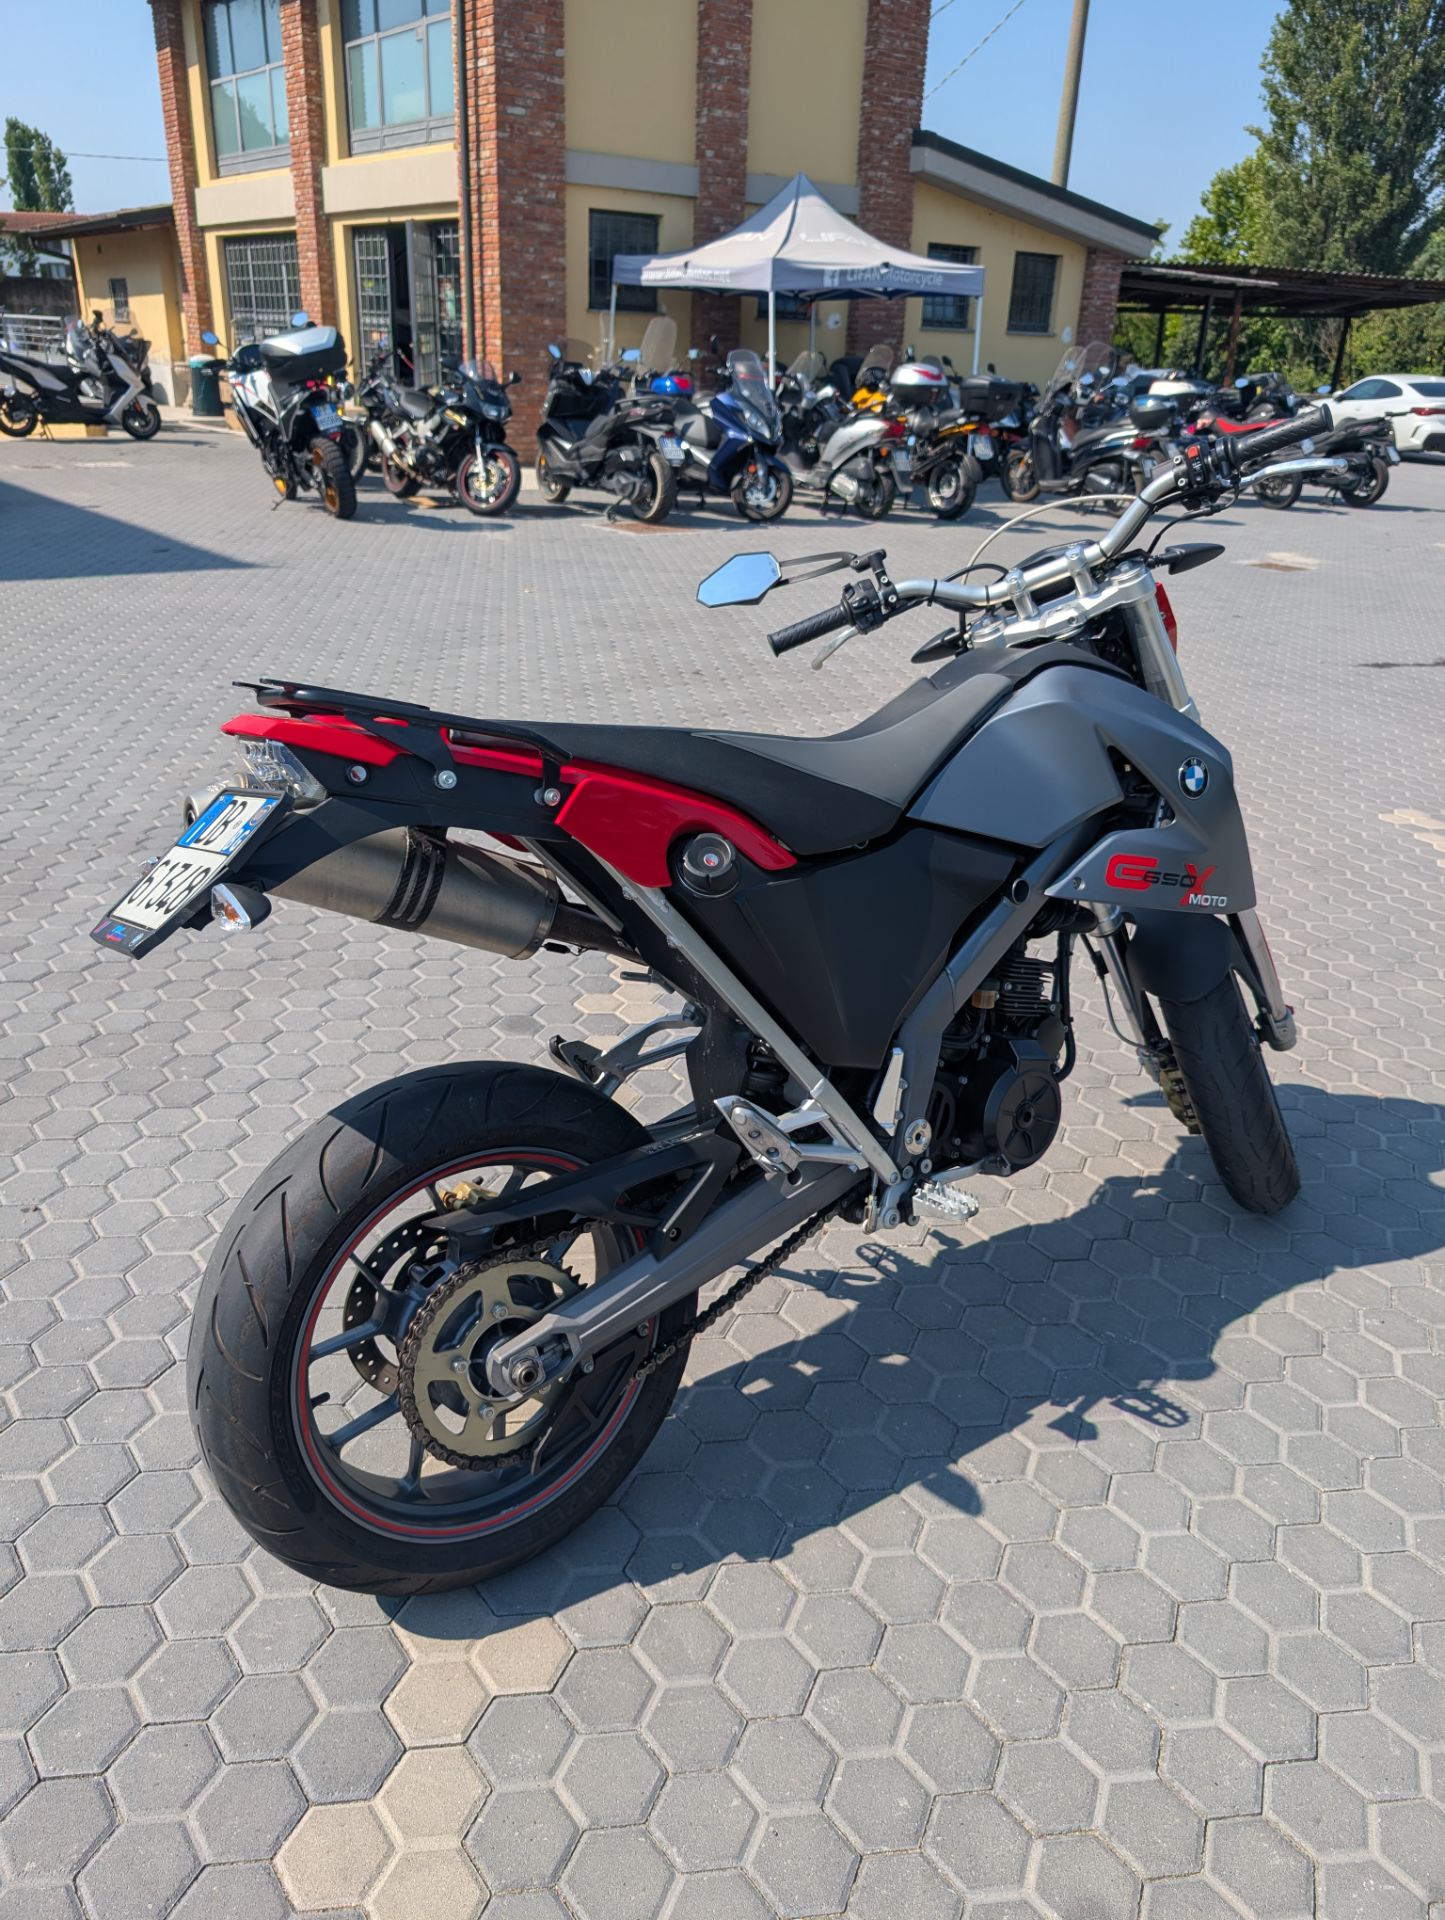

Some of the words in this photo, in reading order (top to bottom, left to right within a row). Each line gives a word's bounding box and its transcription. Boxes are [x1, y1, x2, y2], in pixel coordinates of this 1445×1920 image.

[846, 268, 881, 282] LIFAN
[883, 268, 944, 288] Motorcycle
[196, 799, 248, 846] DB
[127, 860, 211, 915] 61348
[1188, 893, 1228, 907] MOTO
